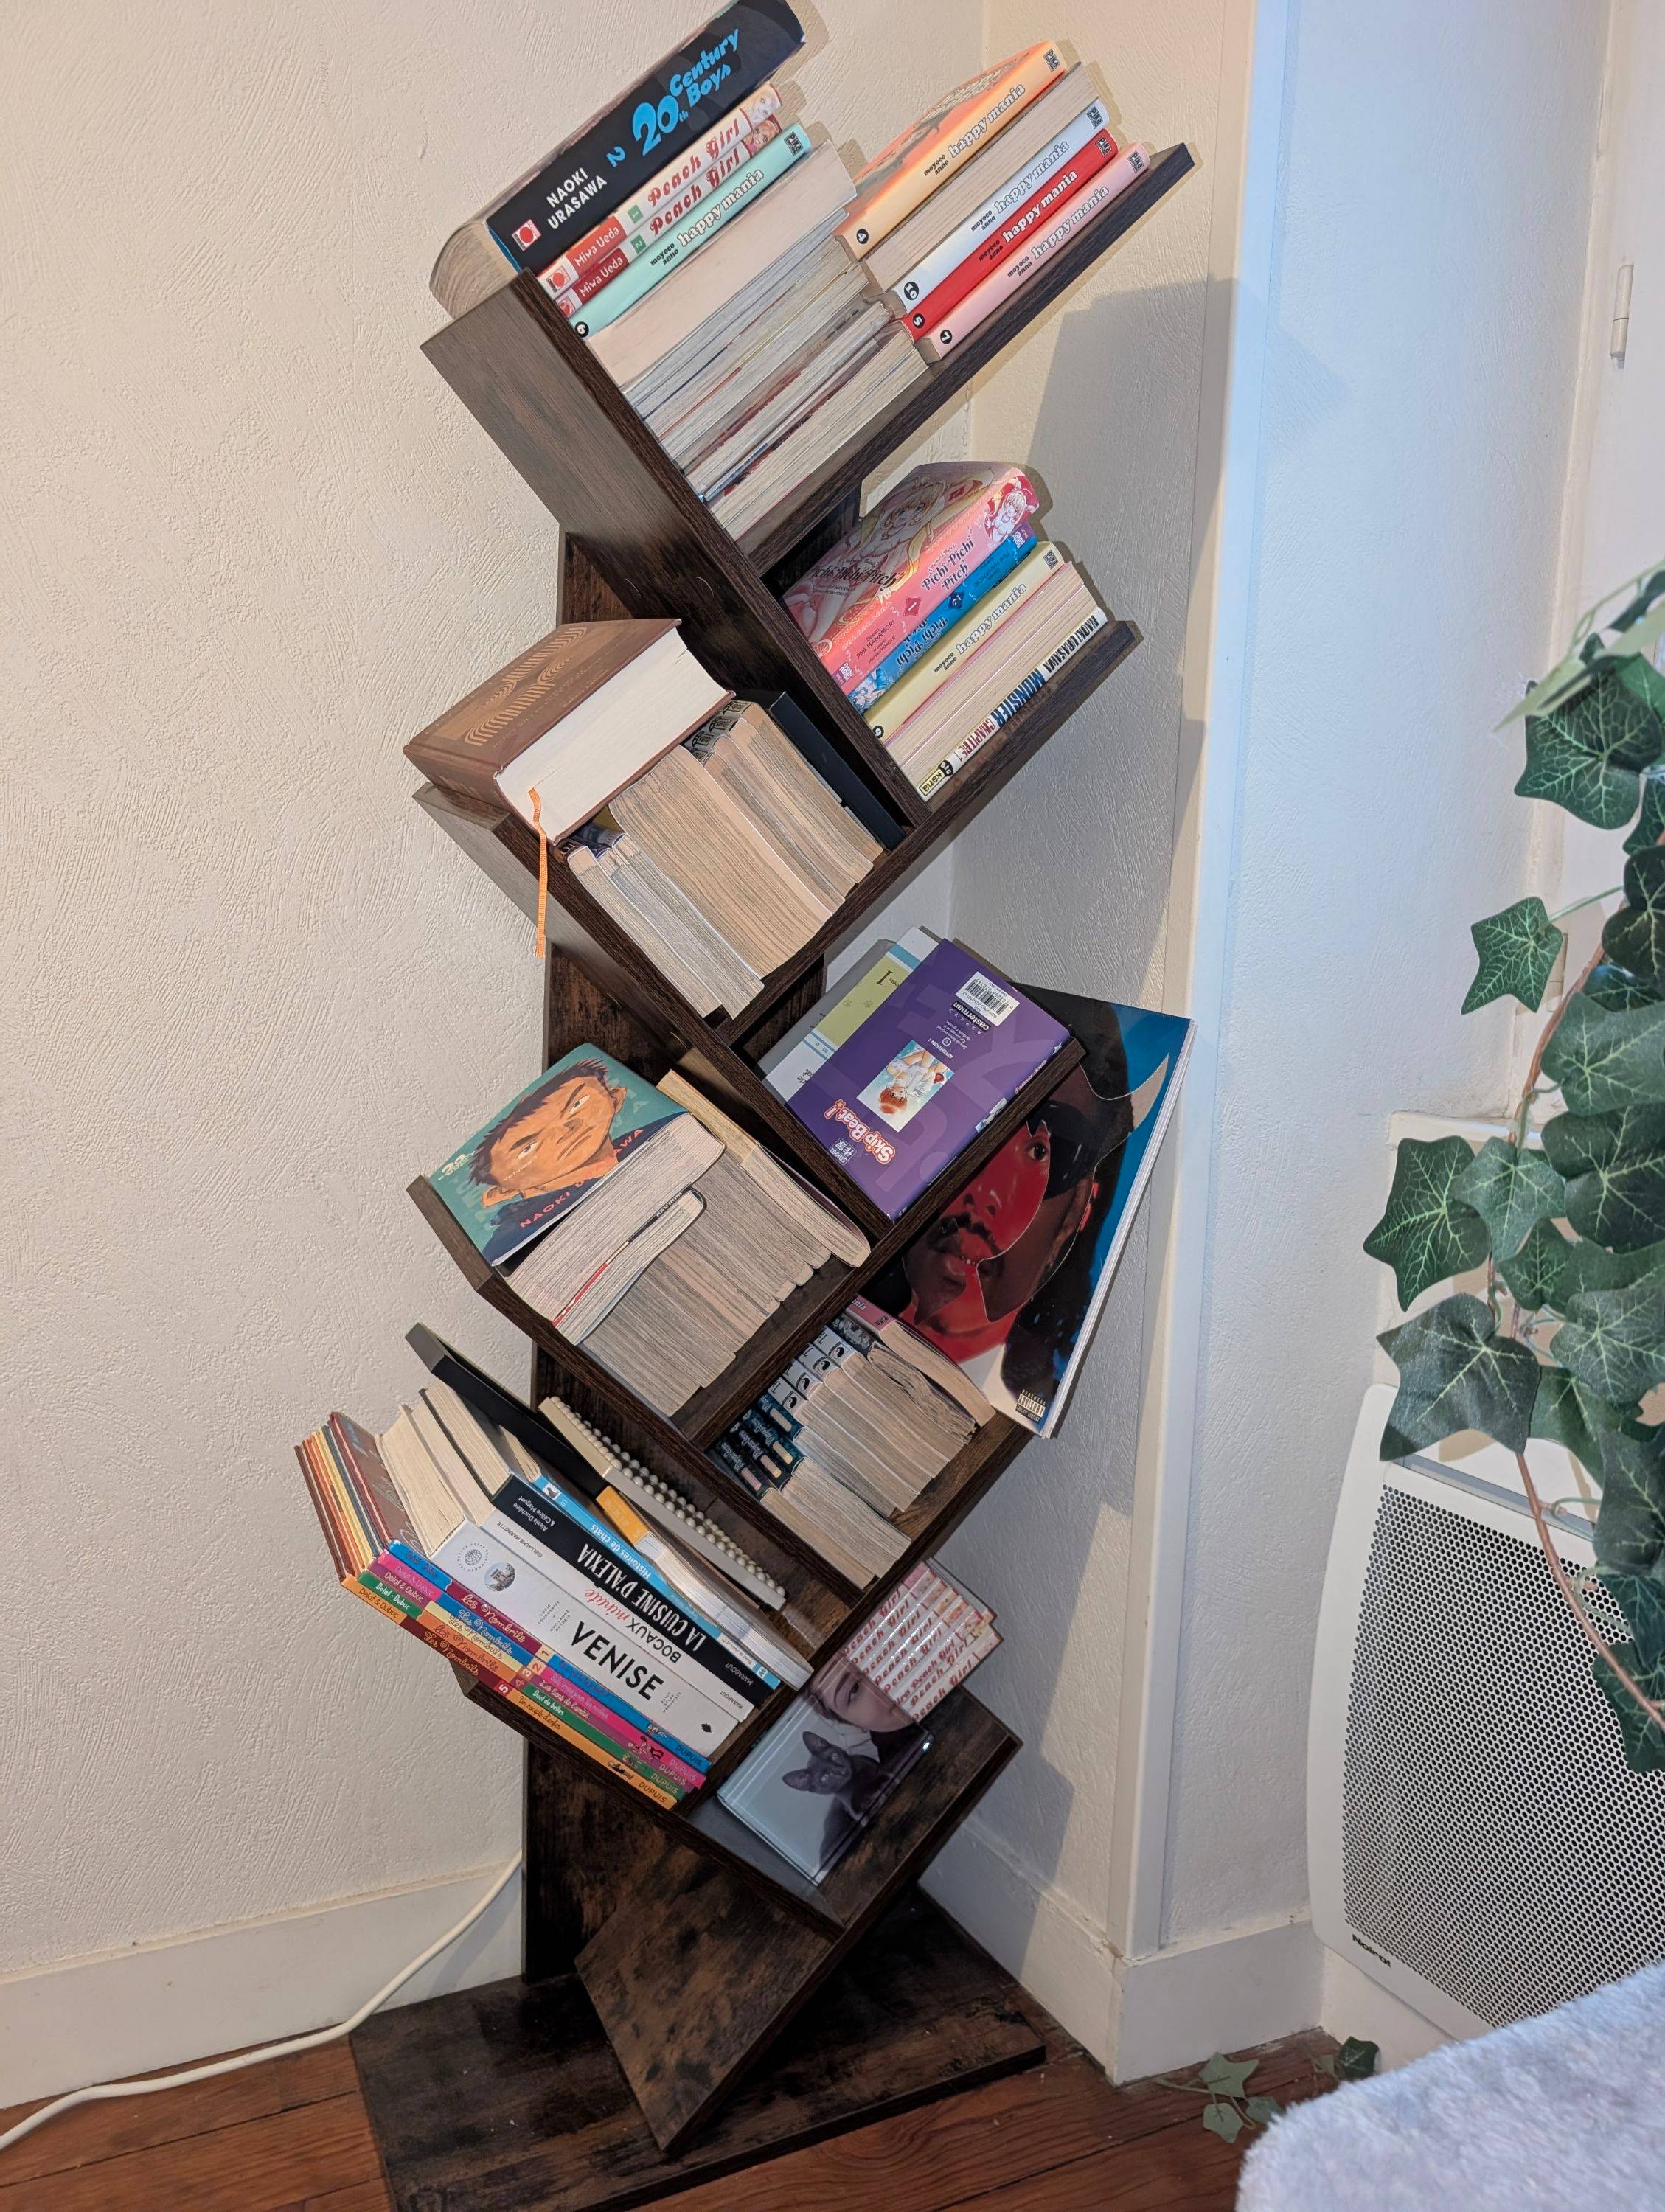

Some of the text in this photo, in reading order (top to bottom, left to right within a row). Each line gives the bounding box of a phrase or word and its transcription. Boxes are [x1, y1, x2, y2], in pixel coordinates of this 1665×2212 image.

[670, 29, 739, 97] Century
[686, 63, 731, 107] Boys
[948, 84, 1025, 158] happy mania
[606, 146, 625, 168] 2
[648, 119, 740, 207] Peach Girl
[924, 154, 946, 176] moyoco
[934, 160, 949, 175] anno
[546, 167, 588, 208] NAOKI
[994, 141, 1069, 213] happy mania
[547, 175, 608, 229] URASAWA
[650, 147, 740, 236] Peach Girl
[677, 170, 764, 247] happy mania
[1003, 170, 1077, 243] happy mania
[970, 209, 993, 232] moyoco
[981, 215, 995, 231] anno
[1031, 186, 1109, 260] happy mania
[574, 226, 620, 268] Miwa Ueda
[857, 231, 868, 243] 4
[979, 239, 1001, 262] moyoco
[650, 243, 675, 266] moyoco
[663, 248, 678, 265] anno
[989, 245, 1004, 260] anno
[579, 256, 623, 298] Miwa Ueda
[1007, 256, 1029, 277] moyoco
[1018, 261, 1032, 276] anno
[906, 284, 918, 299] 10
[577, 324, 587, 335] 6
[914, 316, 923, 326] 5
[942, 332, 951, 342] 7
[922, 563, 949, 590] Pichi
[948, 540, 974, 566] Pichi
[942, 564, 968, 590] Pitch
[922, 616, 948, 641] Pichi
[956, 616, 992, 654] happy
[992, 584, 1026, 620] mania
[856, 620, 895, 659] Pink HANAMORI
[897, 639, 923, 665] Pichi
[1043, 615, 1099, 673] NAOKI URASAWA
[934, 652, 954, 673] moyoco
[944, 657, 957, 671] anno
[990, 668, 1046, 728] MONSTER
[875, 727, 882, 737] 9
[959, 718, 995, 757] CHAPITRE
[922, 771, 943, 793] kana
[953, 1001, 990, 1032] casterman
[931, 1040, 953, 1059] ATTENTION
[835, 1139, 854, 1157] 作家
[863, 1130, 896, 1164] Skip
[520, 1190, 571, 1228] NAOKI
[1018, 1393, 1045, 1418] ADVISORY
[1022, 1388, 1046, 1406] PARENTAL
[513, 1503, 549, 1531] Alexia Duchêne
[518, 1495, 537, 1513] Maguet
[536, 1510, 552, 1523] Céline
[497, 1521, 543, 1558] GUILLAUME MARINETTE
[591, 1524, 652, 1579] Histoires de chats
[577, 1543, 638, 1599] D'ALEXIA
[375, 1582, 392, 1596] Delaf
[393, 1595, 411, 1610] Dubuc
[385, 1572, 400, 1588] Delaf
[406, 1586, 424, 1603] Dubuc
[359, 1588, 375, 1604] Delaf
[380, 1602, 399, 1618] Dubuc
[584, 1587, 630, 1621] minute
[631, 1588, 688, 1637] CUISINE
[473, 1615, 513, 1655] Nombrils
[481, 1603, 526, 1644] Nombrils
[841, 1588, 901, 1657] Peach Girl
[852, 1599, 909, 1665] Peach Girl
[898, 1610, 920, 1637] Girl
[465, 1624, 503, 1660] Nombrils
[625, 1617, 682, 1663] BOCAUX
[685, 1627, 708, 1652] LA
[875, 1618, 932, 1686] Peach Girl
[439, 1642, 479, 1676] Nombrils
[453, 1635, 499, 1672] Nombrils
[571, 1621, 664, 1700] VENISE
[885, 1627, 942, 1694] Peach Girl
[911, 1641, 955, 1688] Peach Girl
[523, 1669, 532, 1677] 3
[532, 1663, 541, 1672] 2
[725, 1662, 754, 1686] MARABOUT
[911, 1638, 967, 1705] Peach Girl
[950, 1660, 972, 1686] Girl
[499, 1686, 508, 1694] 5
[533, 1690, 544, 1701] Duel
[549, 1700, 564, 1716] belles
[720, 1690, 744, 1709] MARABOUT
[526, 1702, 544, 1717] couple
[676, 1745, 703, 1765] DUPUIS
[651, 1773, 679, 1794] DUPUIS
[659, 1764, 686, 1785] DUPUIS
[670, 1759, 697, 1781] DUPUIS
[639, 1781, 667, 1803] DUPUIS
